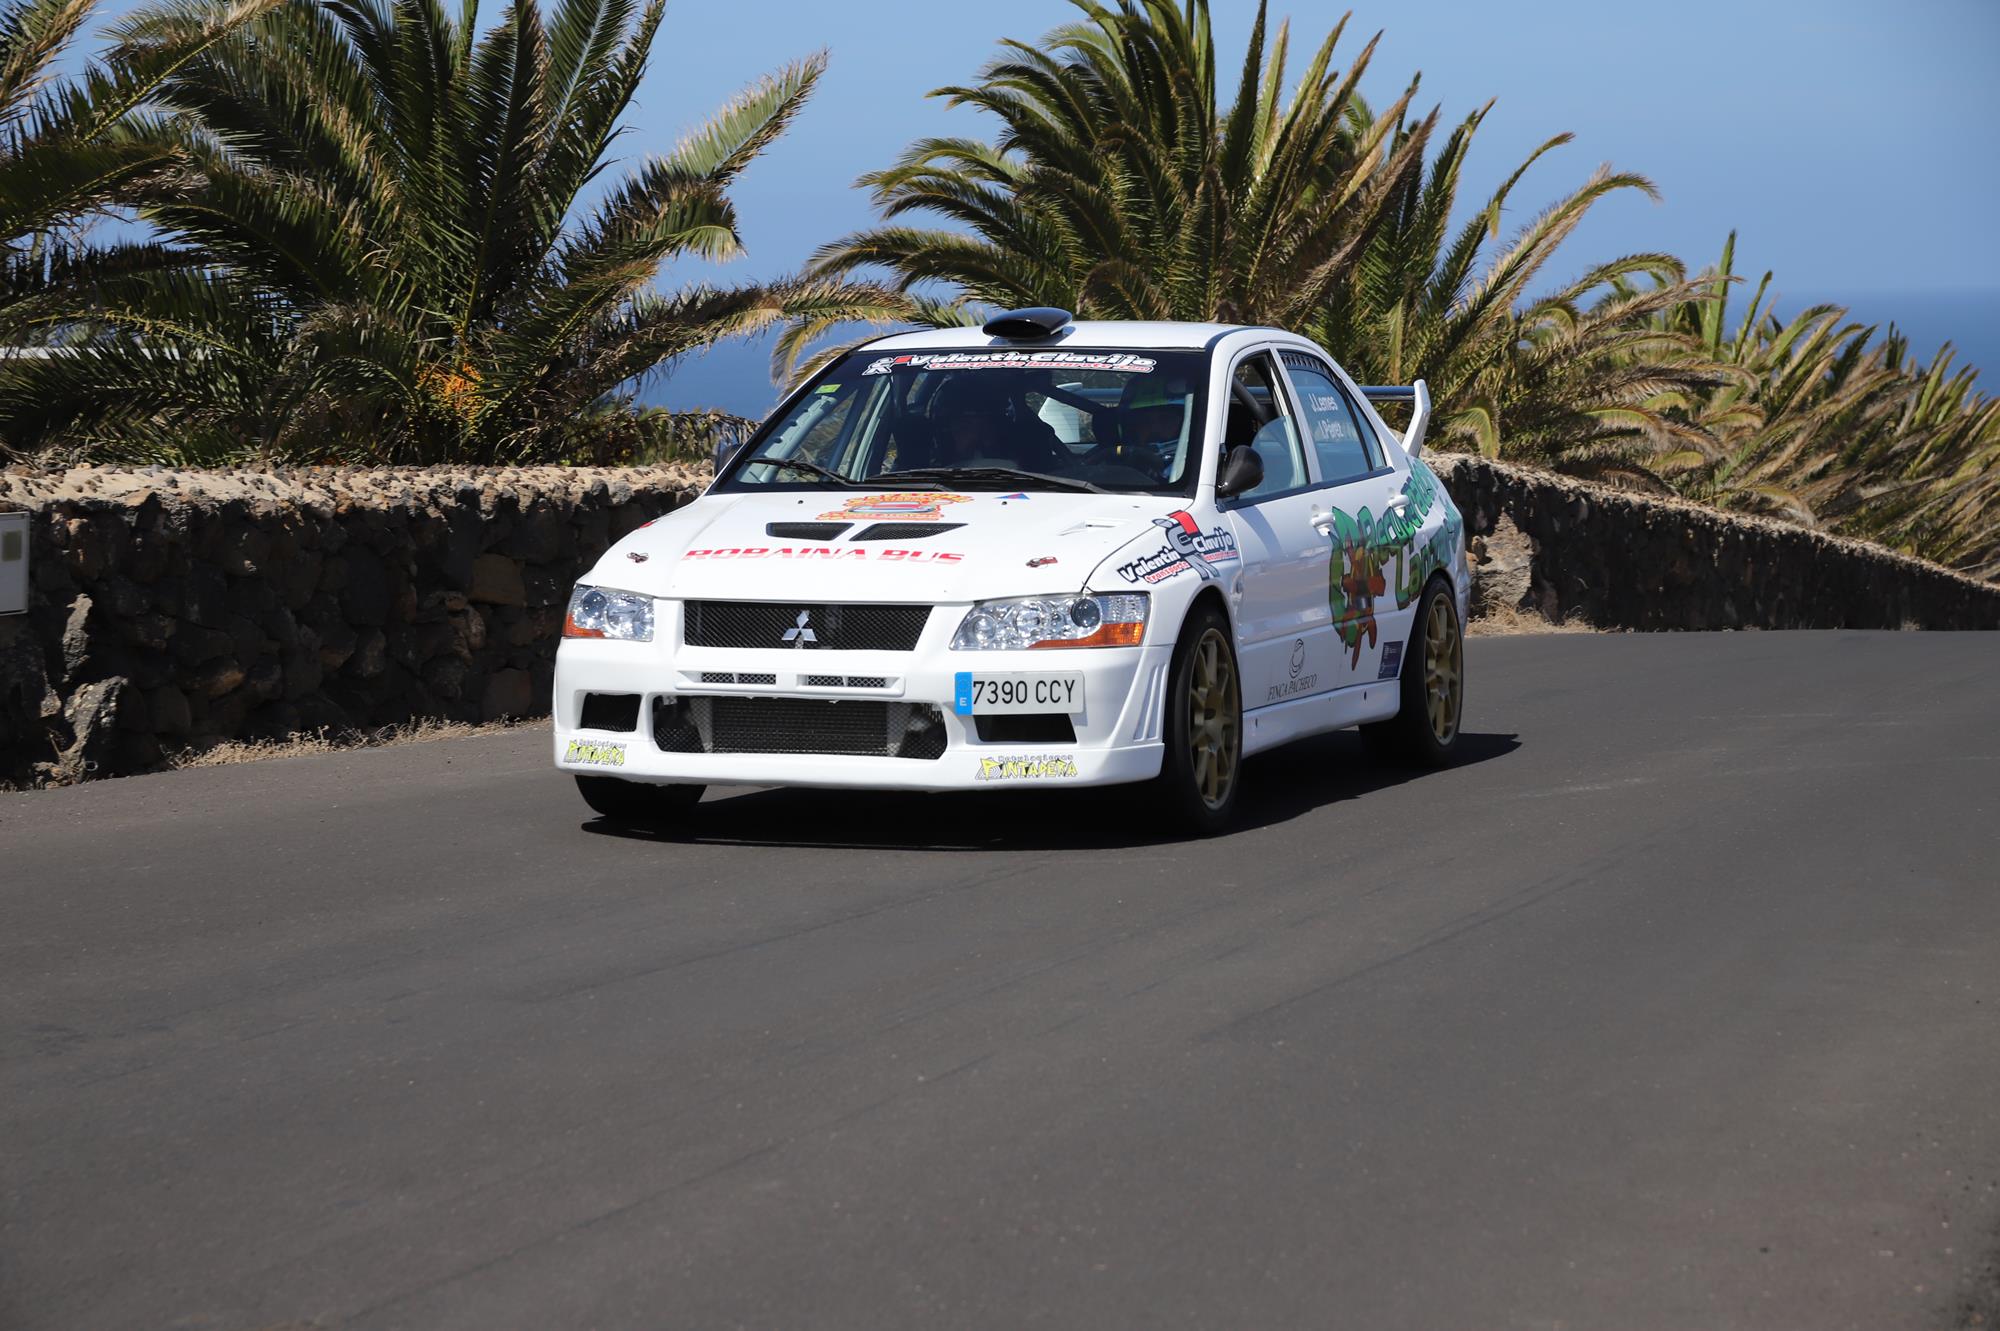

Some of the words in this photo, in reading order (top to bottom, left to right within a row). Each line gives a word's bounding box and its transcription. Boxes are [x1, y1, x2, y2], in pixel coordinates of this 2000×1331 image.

[681, 548, 866, 560] ROBAINA
[877, 549, 965, 565] BUS
[973, 680, 1028, 705] 7390
[1036, 679, 1075, 704] CCY
[959, 697, 967, 706] E
